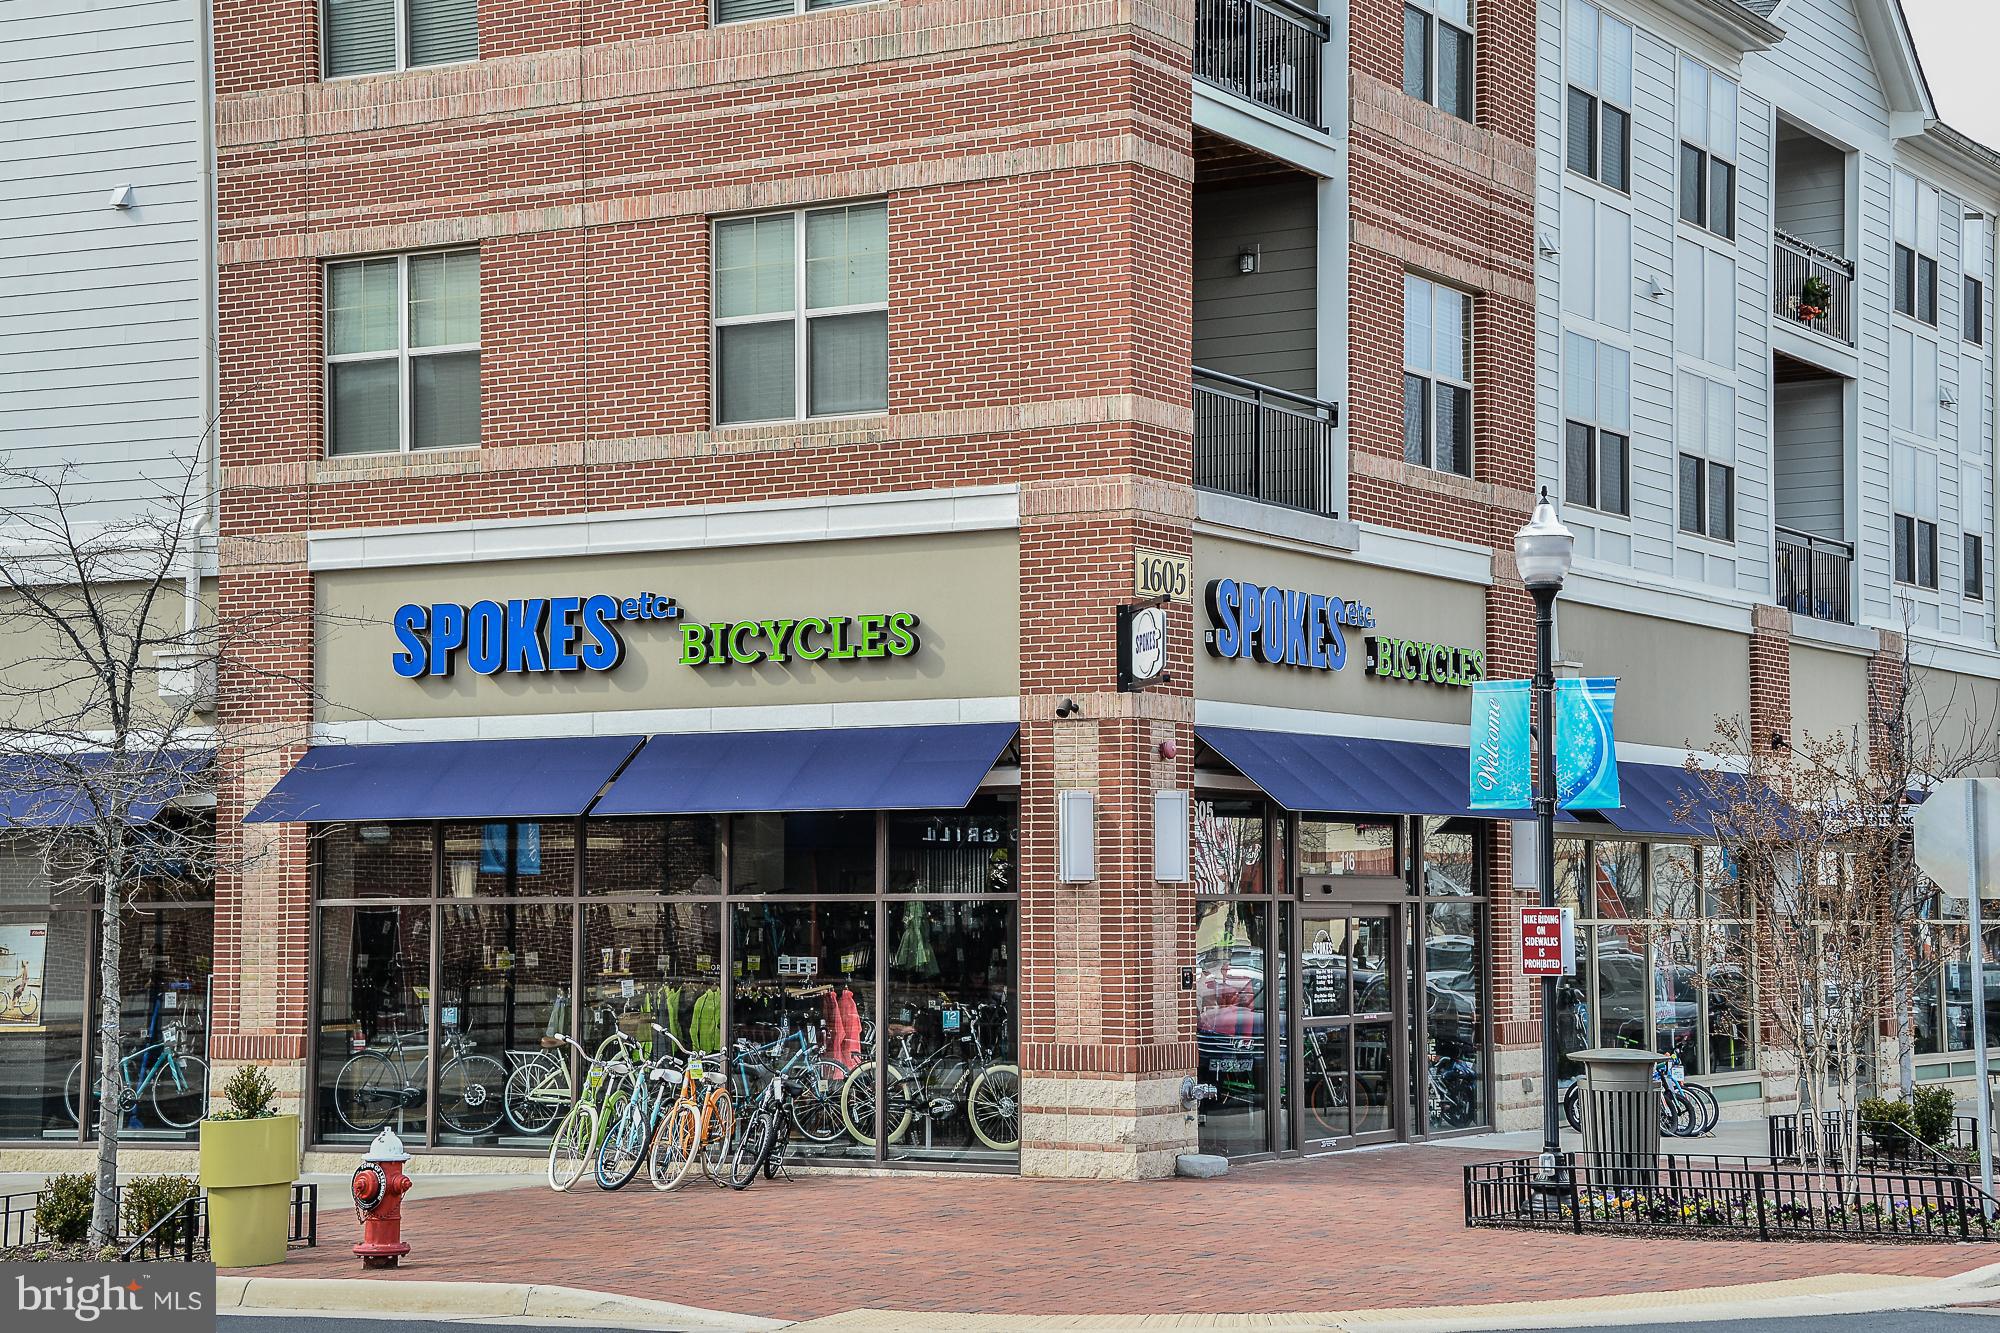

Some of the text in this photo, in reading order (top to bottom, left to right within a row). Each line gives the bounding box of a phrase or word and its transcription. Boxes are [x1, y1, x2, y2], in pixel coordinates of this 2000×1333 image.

[1140, 557, 1187, 595] 1605
[392, 591, 685, 679] SPOKES etc.
[1206, 578, 1348, 672] SPOKES
[678, 611, 922, 666] BICYCLES
[1135, 630, 1157, 654] SPOKES
[1370, 635, 1485, 688] BICYCLES
[1476, 697, 1501, 792] Welcome
[1194, 801, 1214, 822] 05
[1341, 851, 1356, 871] 116
[1523, 914, 1559, 925] BIKE RIDING
[1536, 925, 1546, 936] ON
[1312, 941, 1333, 955] SPOKES
[1524, 936, 1559, 947] SIDEWALKS
[1538, 947, 1546, 958] IS
[1524, 958, 1561, 969] PROHIBITED
[443, 1007, 455, 1016] 12
[945, 1010, 957, 1020] 12
